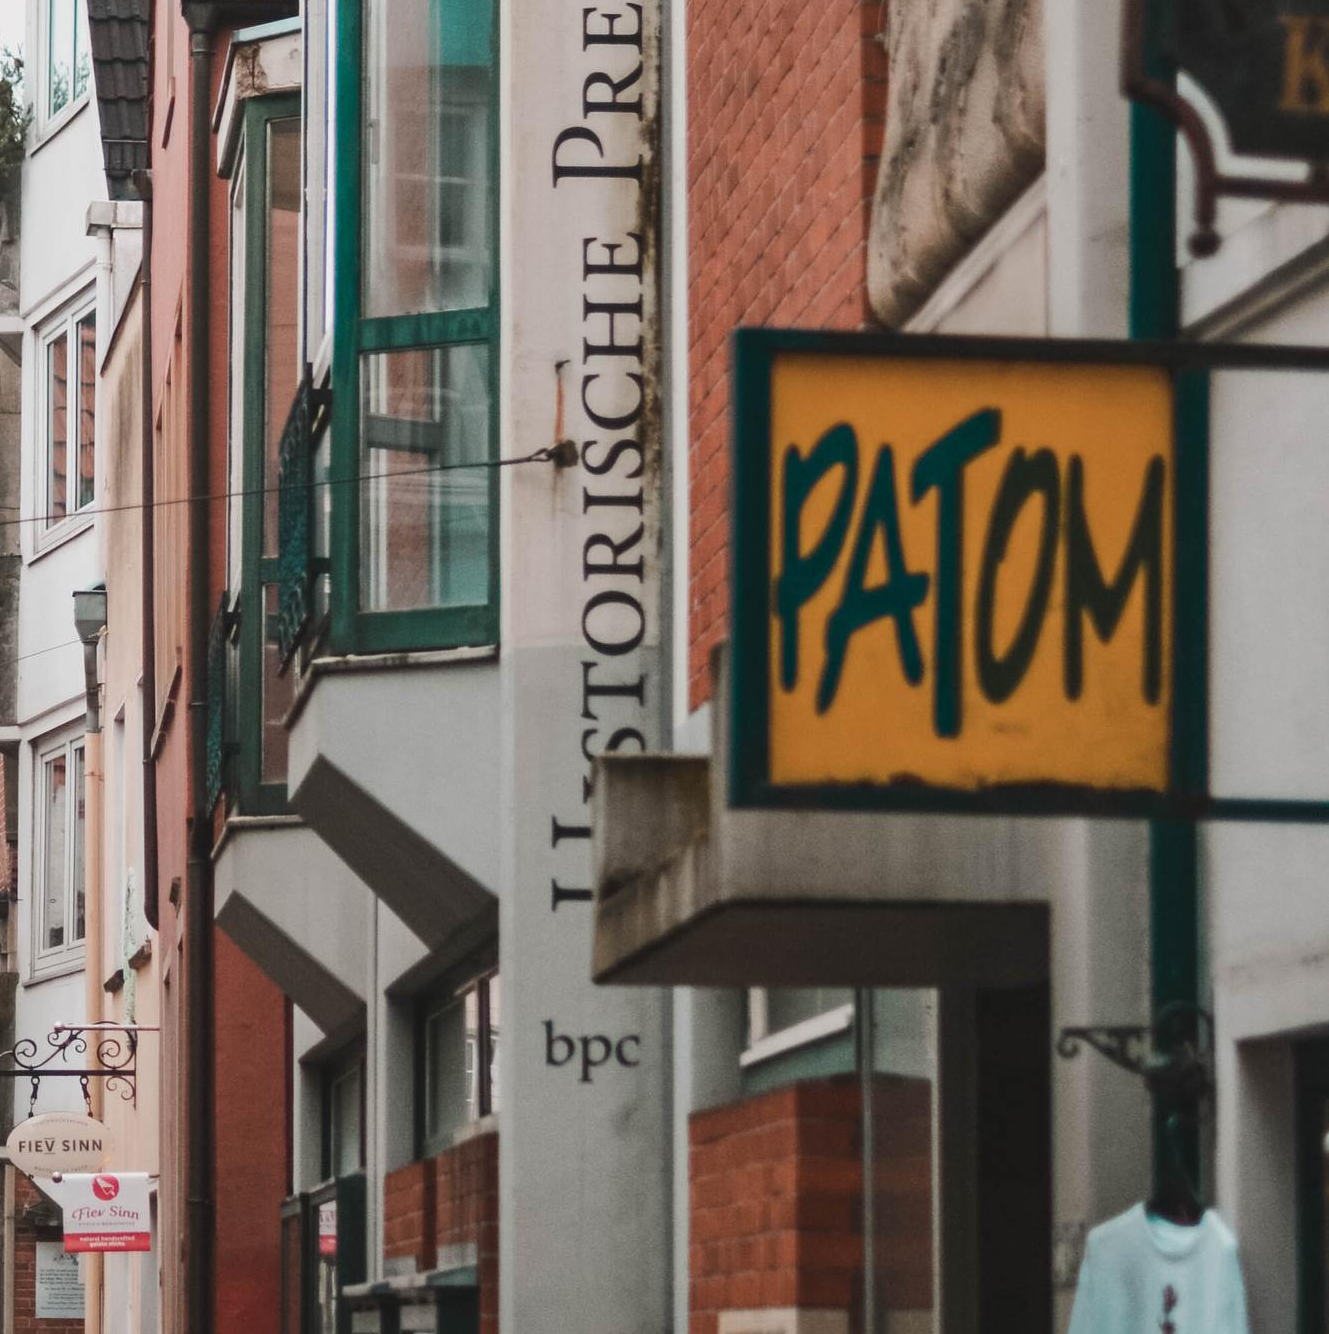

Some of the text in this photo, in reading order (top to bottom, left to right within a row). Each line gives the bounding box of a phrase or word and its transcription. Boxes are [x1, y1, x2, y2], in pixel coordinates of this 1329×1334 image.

[776, 407, 1166, 740] PATOM
[542, 1020, 642, 1083] bpc
[62, 1139, 103, 1153] SINN
[109, 1205, 139, 1220] Sinn
